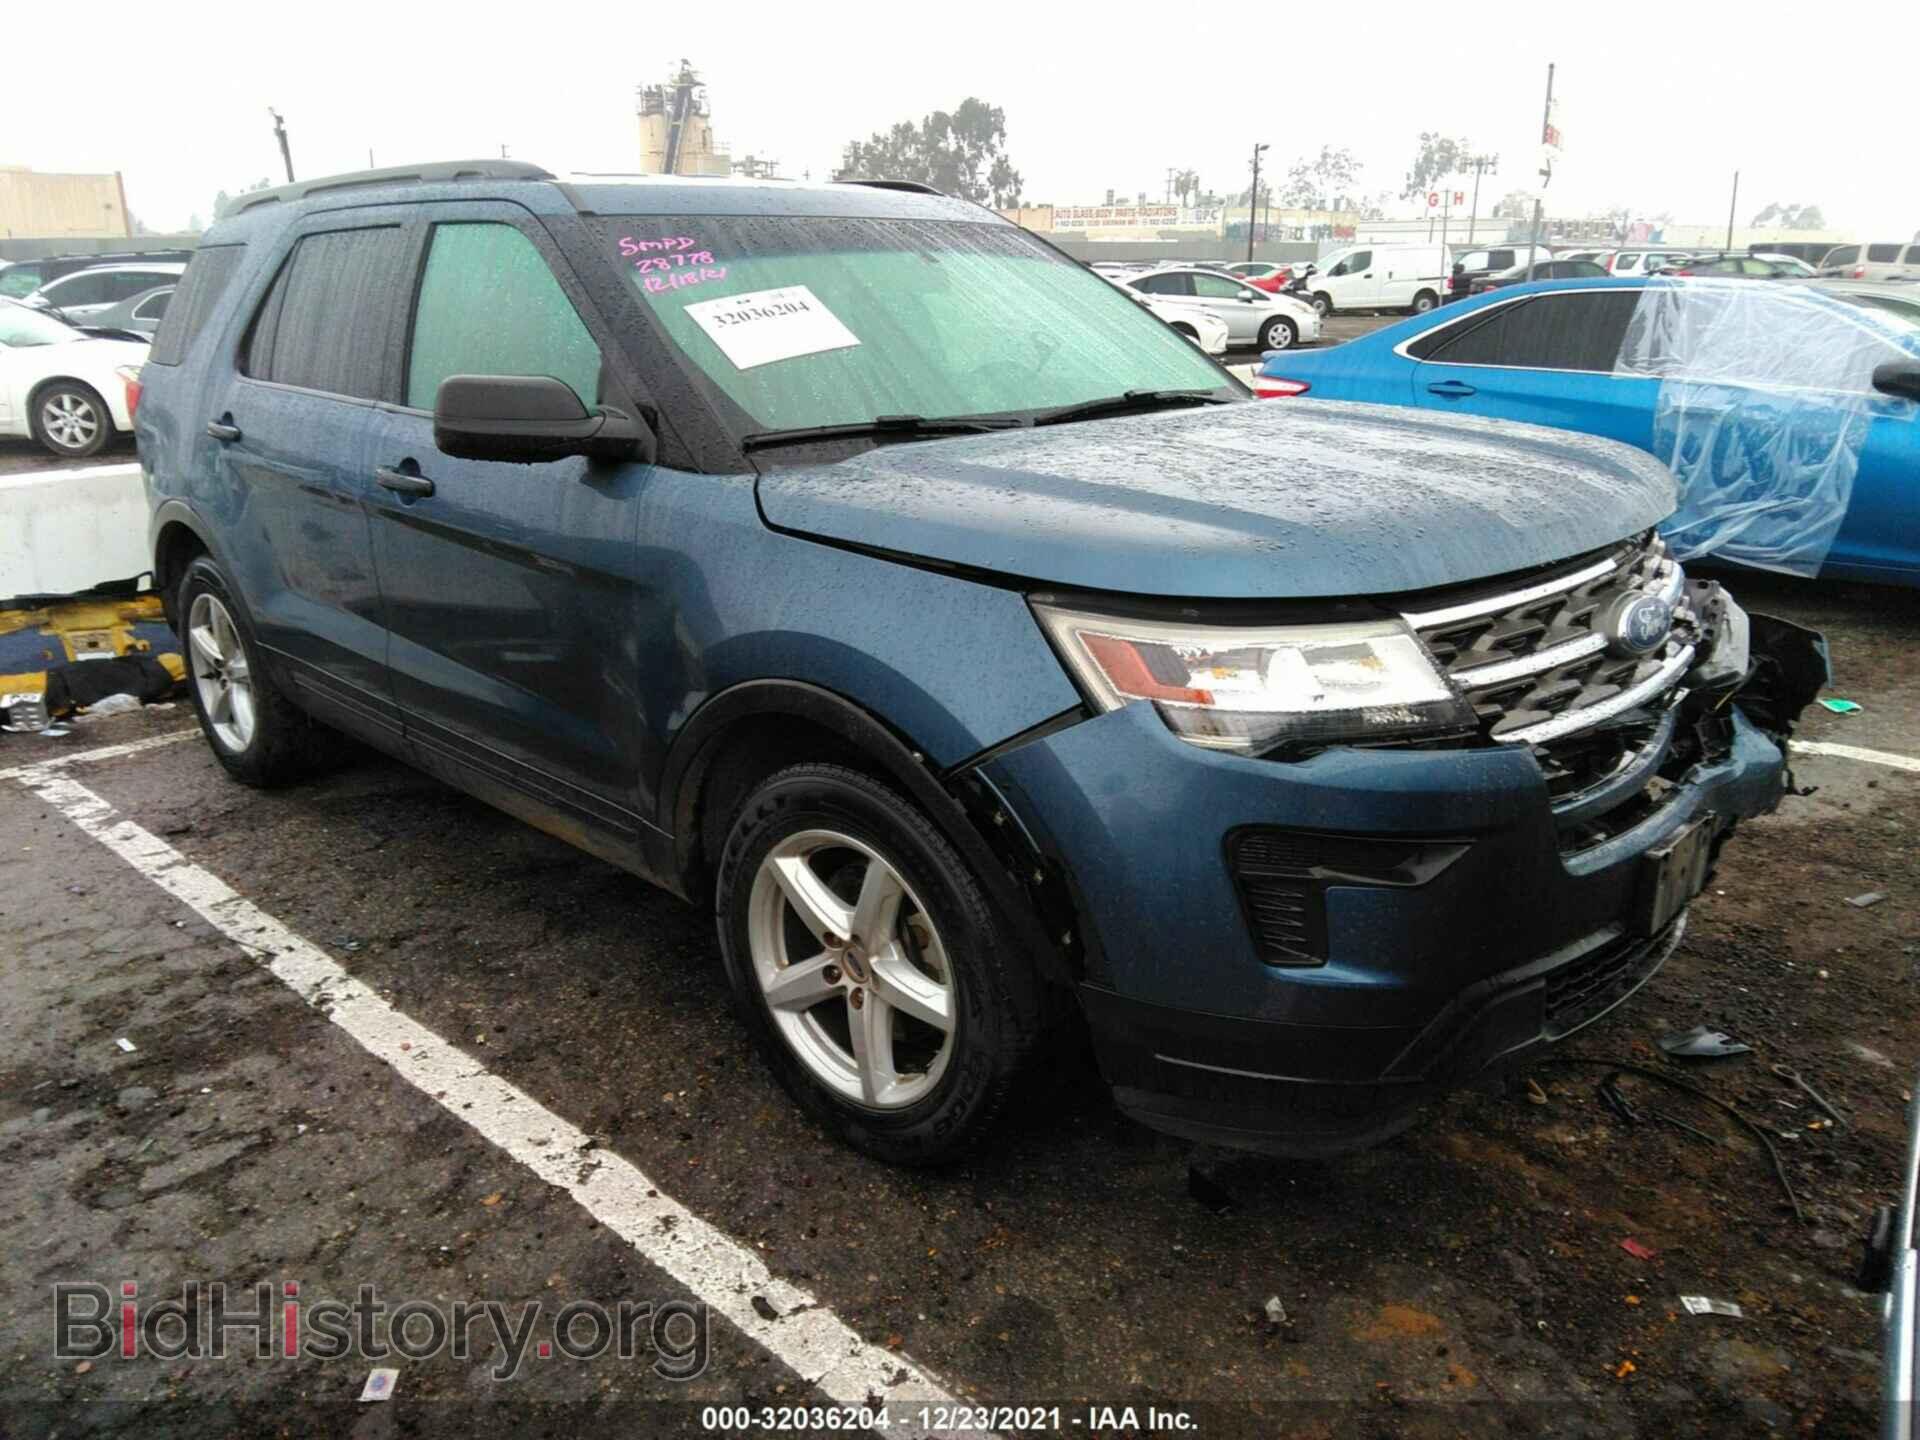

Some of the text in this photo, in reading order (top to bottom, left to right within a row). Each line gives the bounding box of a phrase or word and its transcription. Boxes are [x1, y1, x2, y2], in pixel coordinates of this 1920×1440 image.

[1428, 191, 1464, 207] G H
[635, 250, 715, 274] 28778
[712, 300, 811, 328] 32036204
